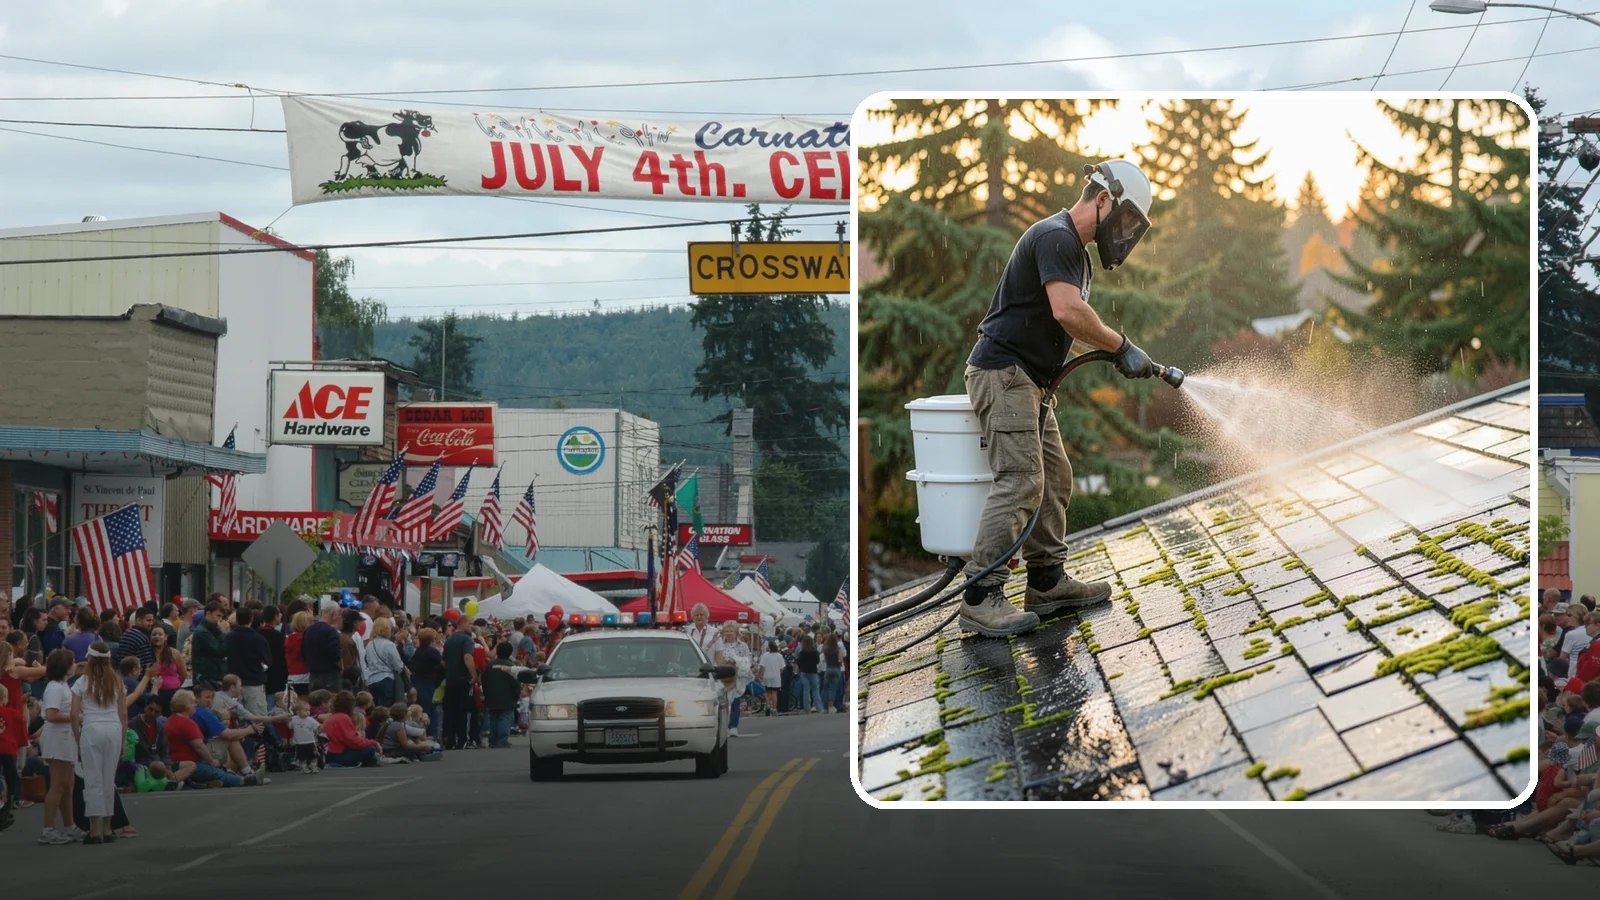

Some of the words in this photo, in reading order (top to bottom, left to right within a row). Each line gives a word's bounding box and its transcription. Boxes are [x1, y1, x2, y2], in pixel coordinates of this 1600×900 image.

[481, 141, 605, 192] JULY
[632, 150, 747, 198] 4th.
[696, 254, 850, 280] CROSSWA
[282, 380, 374, 420] ACE
[405, 409, 453, 421] CEDAR
[283, 421, 371, 436] Hardware
[416, 428, 477, 447] Coca-Cola
[353, 467, 384, 480] Simpl
[83, 485, 93, 494] St.
[96, 485, 124, 495] Vincent
[126, 486, 136, 495] de
[138, 486, 155, 495] Paul
[688, 526, 742, 535] CRNATION
[699, 535, 730, 543] GLASS
